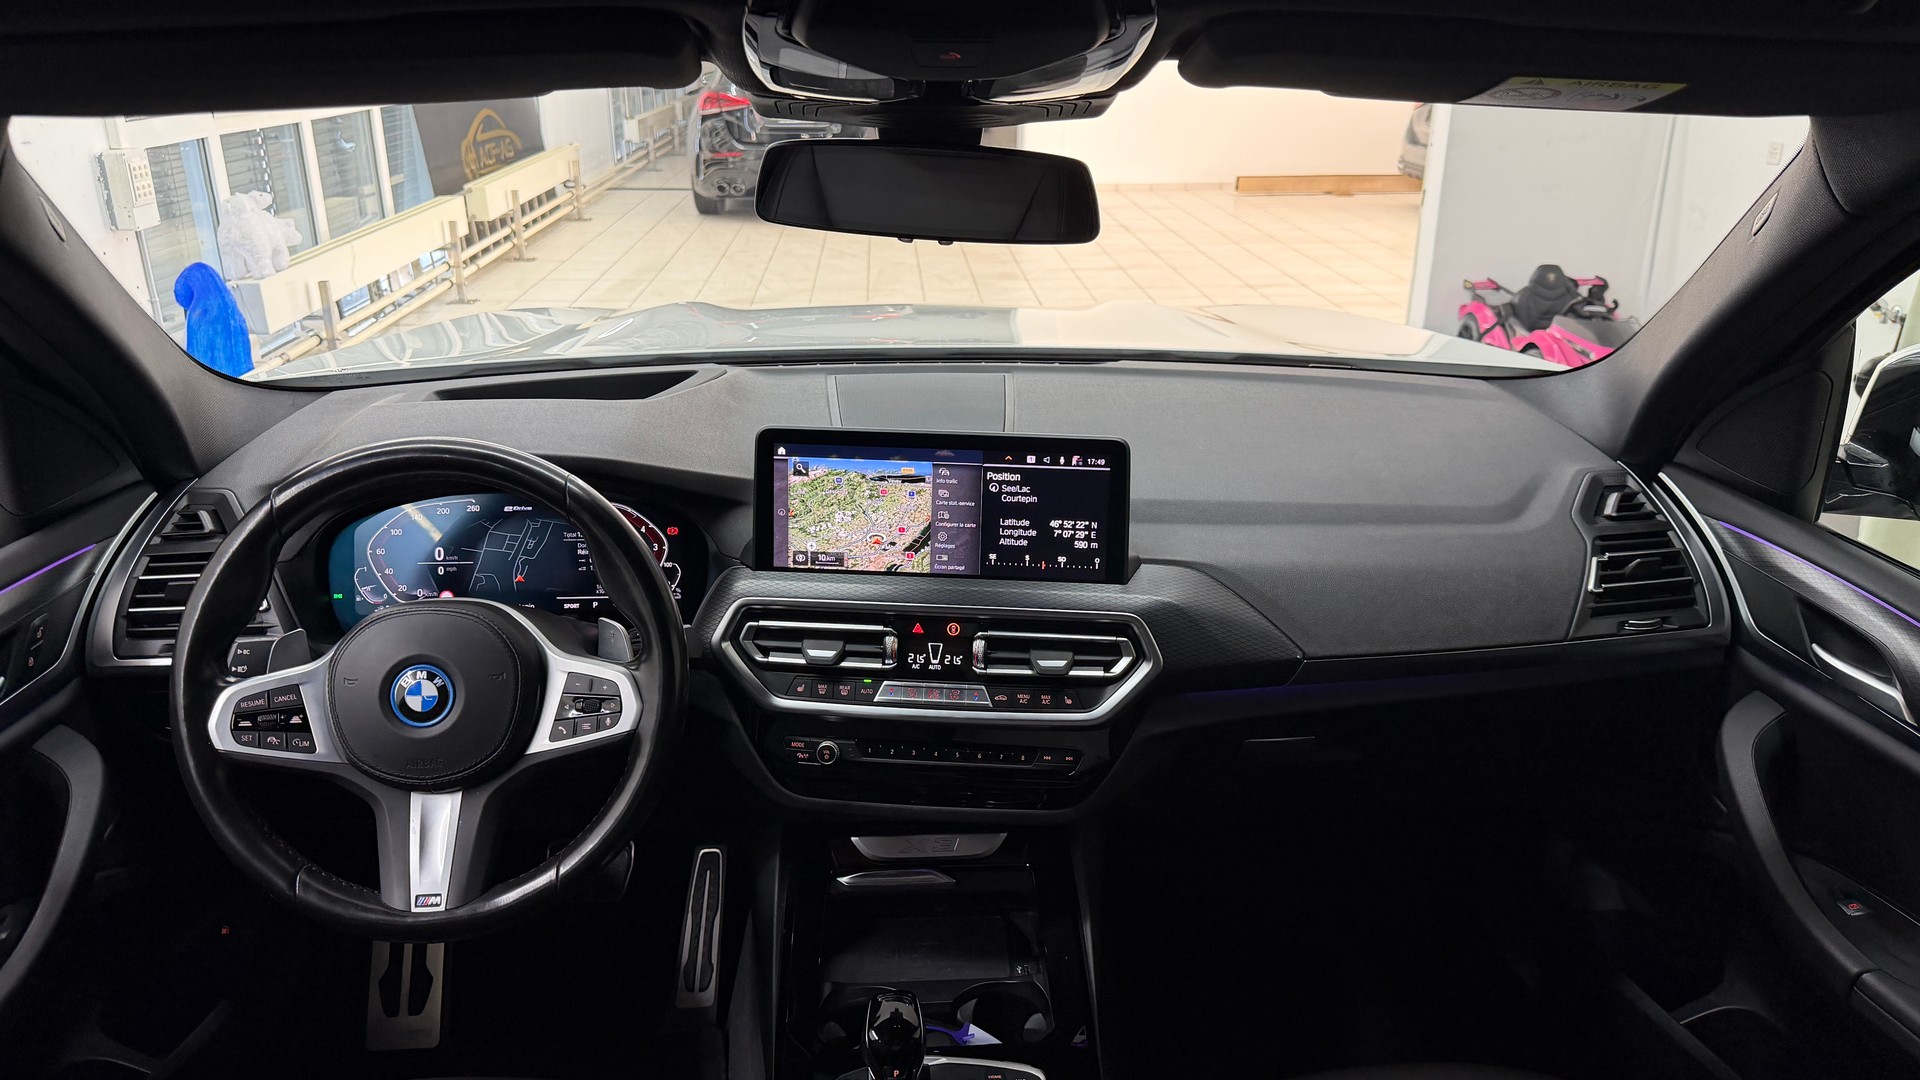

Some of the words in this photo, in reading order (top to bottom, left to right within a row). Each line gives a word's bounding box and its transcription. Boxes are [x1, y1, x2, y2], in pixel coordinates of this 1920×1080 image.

[1087, 458, 1105, 466] 17:49
[986, 472, 1021, 481] Position
[1001, 484, 1031, 493] See/Lac
[1001, 494, 1038, 503] Courtepin
[1000, 518, 1030, 526] Latitude
[1091, 521, 1098, 529] N
[640, 525, 646, 533] 4
[999, 528, 1037, 538] Longitude
[1091, 531, 1097, 539] E
[999, 538, 1028, 546] Altitude
[1074, 541, 1088, 549] 590
[434, 547, 444, 560] 0
[438, 566, 444, 575] 0
[416, 589, 423, 597] 0
[400, 670, 445, 688] BMW
[240, 698, 266, 708] RESUME
[274, 694, 297, 703] CANCEL
